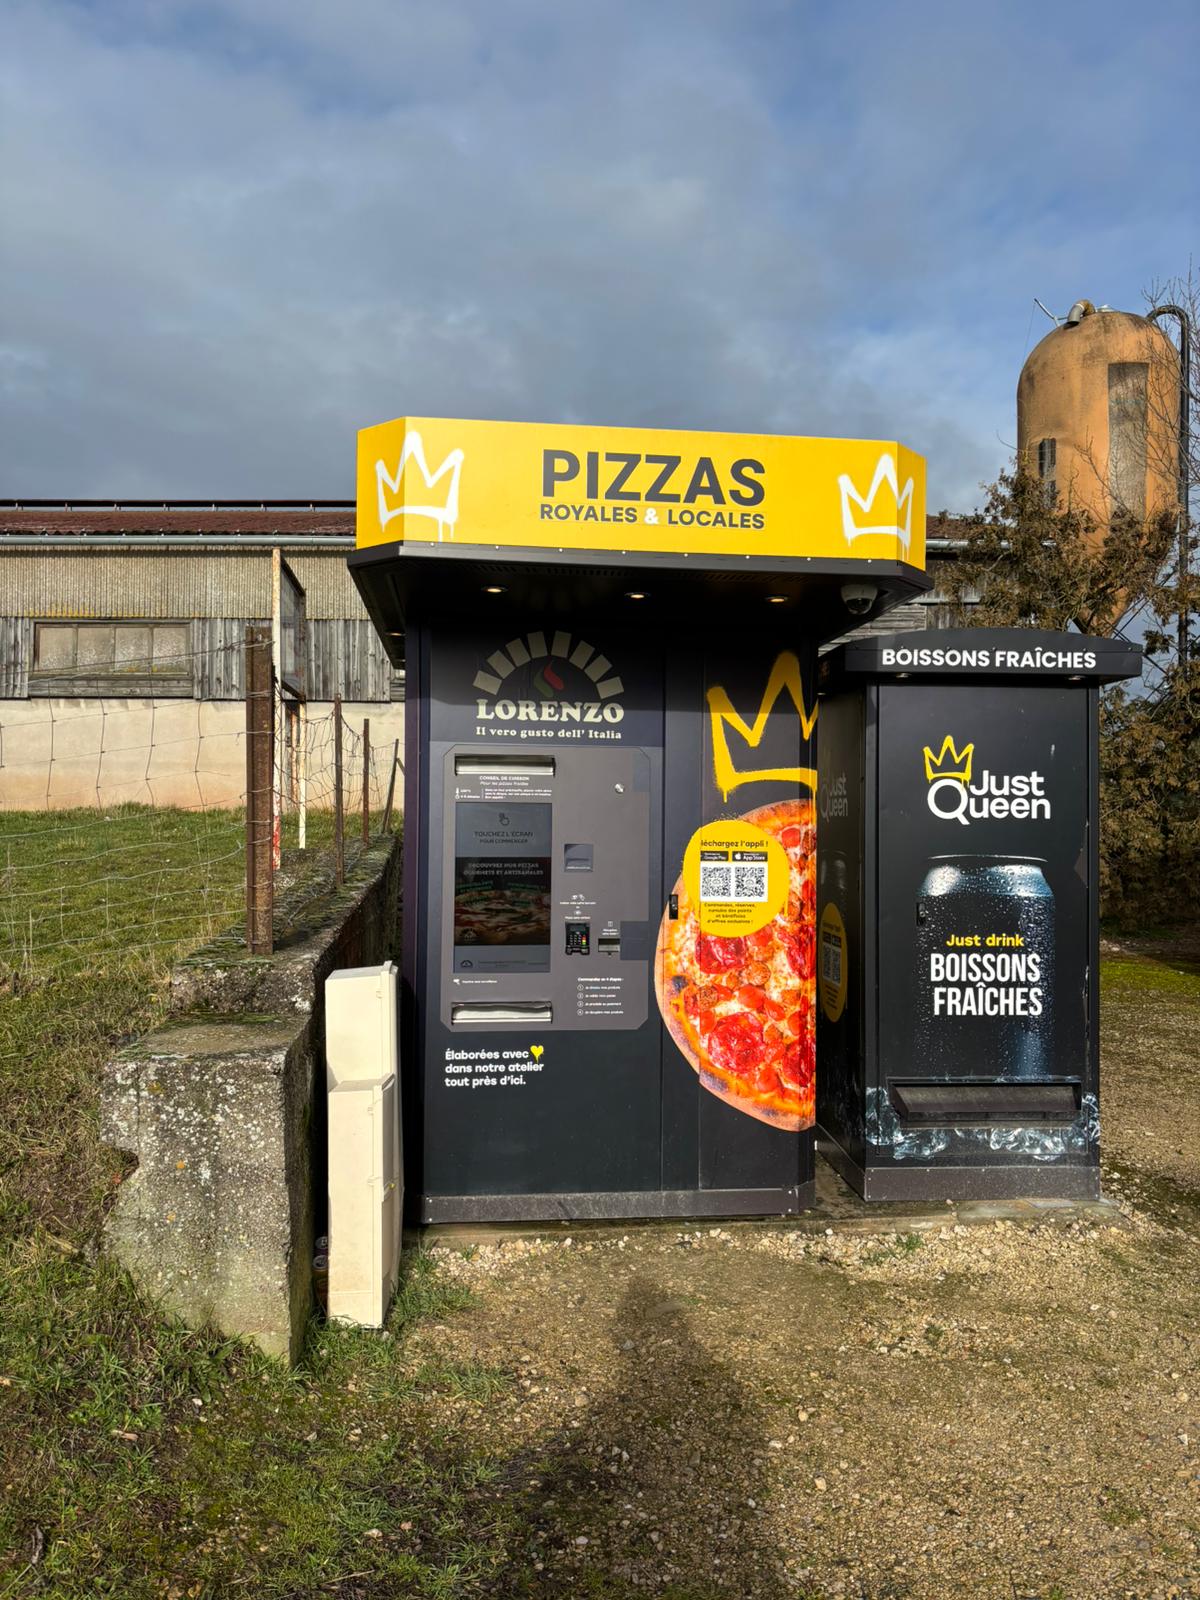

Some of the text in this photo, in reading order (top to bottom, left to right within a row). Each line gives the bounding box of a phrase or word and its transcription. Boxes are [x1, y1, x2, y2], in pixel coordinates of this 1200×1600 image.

[542, 448, 765, 507] PIZZAS
[540, 503, 765, 530] ROYALES & LOCALES
[883, 647, 1097, 669] BOISSONS FRAÎCHES
[476, 698, 625, 724] LORENZO
[476, 726, 622, 740] Il vero gusto dell' Italia
[969, 769, 1046, 797] Just
[927, 778, 1051, 825] Queen
[739, 840, 764, 849] l'appli
[765, 840, 768, 848] !
[946, 933, 1024, 947] Just drink
[930, 953, 1041, 982] BOISSONS
[934, 982, 1043, 1016] FRAÎCHES
[445, 1048, 529, 1060] Élaborées avec
[445, 1061, 545, 1074] dans notre atelier
[444, 1074, 526, 1089] tout près d'ici.
